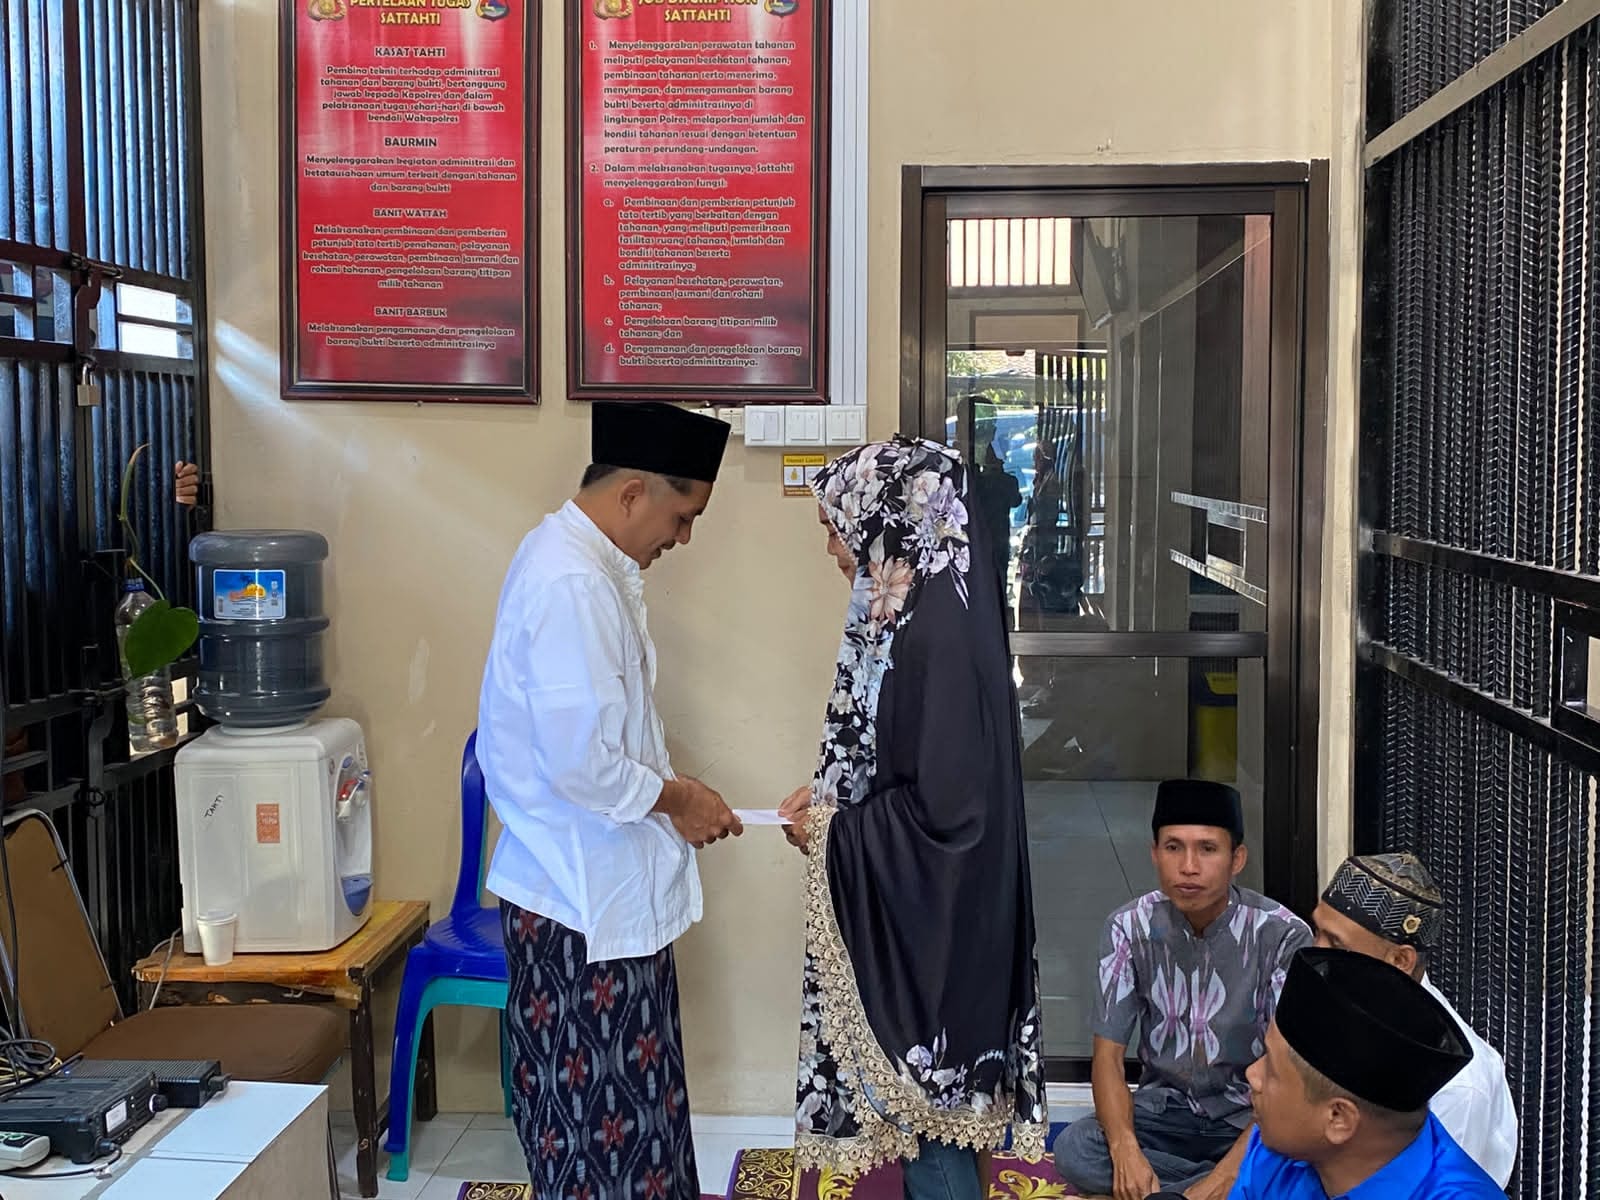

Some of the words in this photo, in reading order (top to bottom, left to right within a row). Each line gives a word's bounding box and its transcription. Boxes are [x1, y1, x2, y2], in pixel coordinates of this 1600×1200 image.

[380, 12, 441, 25] SATTAHTI
[664, 9, 731, 21] SATTAHTI
[609, 41, 698, 50] Menyelenggarakan
[701, 41, 752, 51] perawatan
[755, 41, 795, 49] tahanan
[375, 48, 409, 56] KASAT
[413, 48, 446, 56] TAHTI
[604, 56, 642, 65] meliputi
[645, 56, 694, 65] pelayanan
[697, 56, 744, 64] kesehatan
[327, 66, 367, 74] Pembina
[370, 66, 397, 75] teknis
[399, 67, 441, 77] terhadap
[444, 67, 499, 75] administrasi
[604, 71, 656, 81] pembinaan
[659, 71, 698, 79] tahanan
[701, 71, 723, 79] serta
[321, 78, 360, 86] tahanan
[362, 78, 378, 87] dan
[382, 79, 414, 88] barang
[447, 79, 505, 89] bertanggung
[334, 90, 362, 100] jawab
[364, 90, 400, 100] kepada
[402, 91, 441, 100] Kapolres
[444, 91, 460, 99] dan
[464, 91, 492, 99] dalam
[665, 85, 682, 94] dan
[685, 86, 756, 95] mengamankan
[759, 86, 792, 96] barang
[322, 102, 381, 111] pelaksanaan
[383, 102, 408, 112] tugas
[411, 102, 459, 111] sehari-hari
[463, 103, 470, 111] di
[473, 103, 504, 111] bawah
[604, 100, 628, 108] bukti
[631, 100, 664, 108] beserta
[668, 100, 741, 110] administrasinya
[745, 100, 753, 109] di
[368, 113, 402, 122] kendali
[404, 114, 459, 124] Wakapolres
[604, 115, 657, 125] lingkungan
[693, 115, 749, 125] melaporkan
[751, 115, 784, 125] jumlah
[787, 115, 804, 123] dan
[604, 129, 637, 138] kondisi
[639, 129, 678, 138] tahanan
[681, 129, 708, 138] sesuai
[711, 130, 745, 139] dengan
[749, 130, 797, 138] ketentuan
[385, 138, 437, 146] BAURMIN
[605, 145, 650, 154] peraturan
[306, 156, 393, 166] Menyelenggarakan
[396, 157, 436, 167] kegiatan
[440, 157, 494, 166] administrasi
[498, 158, 514, 166] dan
[591, 164, 599, 172] 2.
[605, 164, 634, 172] Dalam
[638, 164, 705, 172] melaksanakan
[757, 164, 793, 172] Sattahti
[305, 169, 373, 177] ketatausahaan
[408, 170, 438, 178] terkait
[441, 171, 474, 181] dengan
[478, 171, 516, 180] tahanan
[371, 183, 388, 191] dan
[391, 183, 423, 193] barang
[426, 183, 450, 192] bukti
[605, 178, 693, 188] menyelenggarakan
[624, 197, 677, 206] Pembinaan
[680, 198, 698, 206] dan
[700, 198, 749, 208] pemberian
[752, 198, 795, 208] petunjuk
[374, 209, 401, 217] BANIT
[405, 209, 447, 217] WATTAH
[619, 211, 637, 219] tata
[642, 211, 667, 219] tertib
[670, 212, 692, 221] yang
[695, 211, 741, 219] berkaitan
[744, 211, 777, 221] dengan
[315, 226, 381, 234] Melaksanakan
[384, 227, 434, 237] pembinaan
[438, 227, 453, 235] dan
[457, 228, 506, 238] pemberian
[664, 225, 686, 233] yang
[690, 224, 728, 233] meliputi
[731, 224, 790, 234] pemeriksaan
[312, 239, 352, 249] petunjuk
[355, 239, 373, 248] tata
[377, 240, 401, 248] tertib
[462, 241, 509, 251] pelayanan
[619, 236, 655, 244] fasilitas
[657, 238, 683, 246] ruang
[731, 236, 764, 246] jumlah
[767, 237, 784, 245] dan
[619, 249, 650, 257] kondisi
[655, 249, 693, 257] tahanan
[697, 249, 729, 257] beserta
[409, 254, 460, 264] pembinaan
[463, 255, 497, 264] jasmani
[502, 255, 519, 263] dan
[312, 265, 340, 273] rohani
[386, 267, 441, 276] pengelolaan
[443, 267, 476, 277] barang
[479, 268, 510, 278] titipan
[379, 280, 400, 288] milik
[403, 280, 442, 288] tahanan
[605, 277, 614, 285] b.
[624, 276, 673, 286] Pelayanan
[620, 289, 672, 299] pembinaan
[674, 289, 709, 299] jasmani
[713, 289, 730, 297] dan
[733, 289, 762, 297] rohani
[375, 308, 404, 316] BANIT
[407, 308, 447, 316] BARBUK
[605, 318, 614, 326] c.
[625, 317, 681, 327] Pengelolaan
[684, 317, 717, 327] barang
[720, 317, 750, 327] titipan
[753, 317, 777, 325] milik
[309, 324, 373, 332] Melaksanakan
[376, 327, 435, 335] pengamanan
[439, 326, 456, 334] dan
[459, 327, 514, 337] pengelolaan
[664, 329, 682, 338] dan
[327, 337, 359, 347] barang
[362, 338, 385, 346] bukti
[388, 339, 421, 347] beserta
[424, 340, 495, 350] administrasinya
[625, 344, 686, 354] Pengamanan
[689, 345, 706, 353] dan
[709, 345, 765, 355] pengelolaan
[768, 345, 800, 355] barang
[620, 357, 644, 365] bukti
[647, 357, 679, 365] beserta
